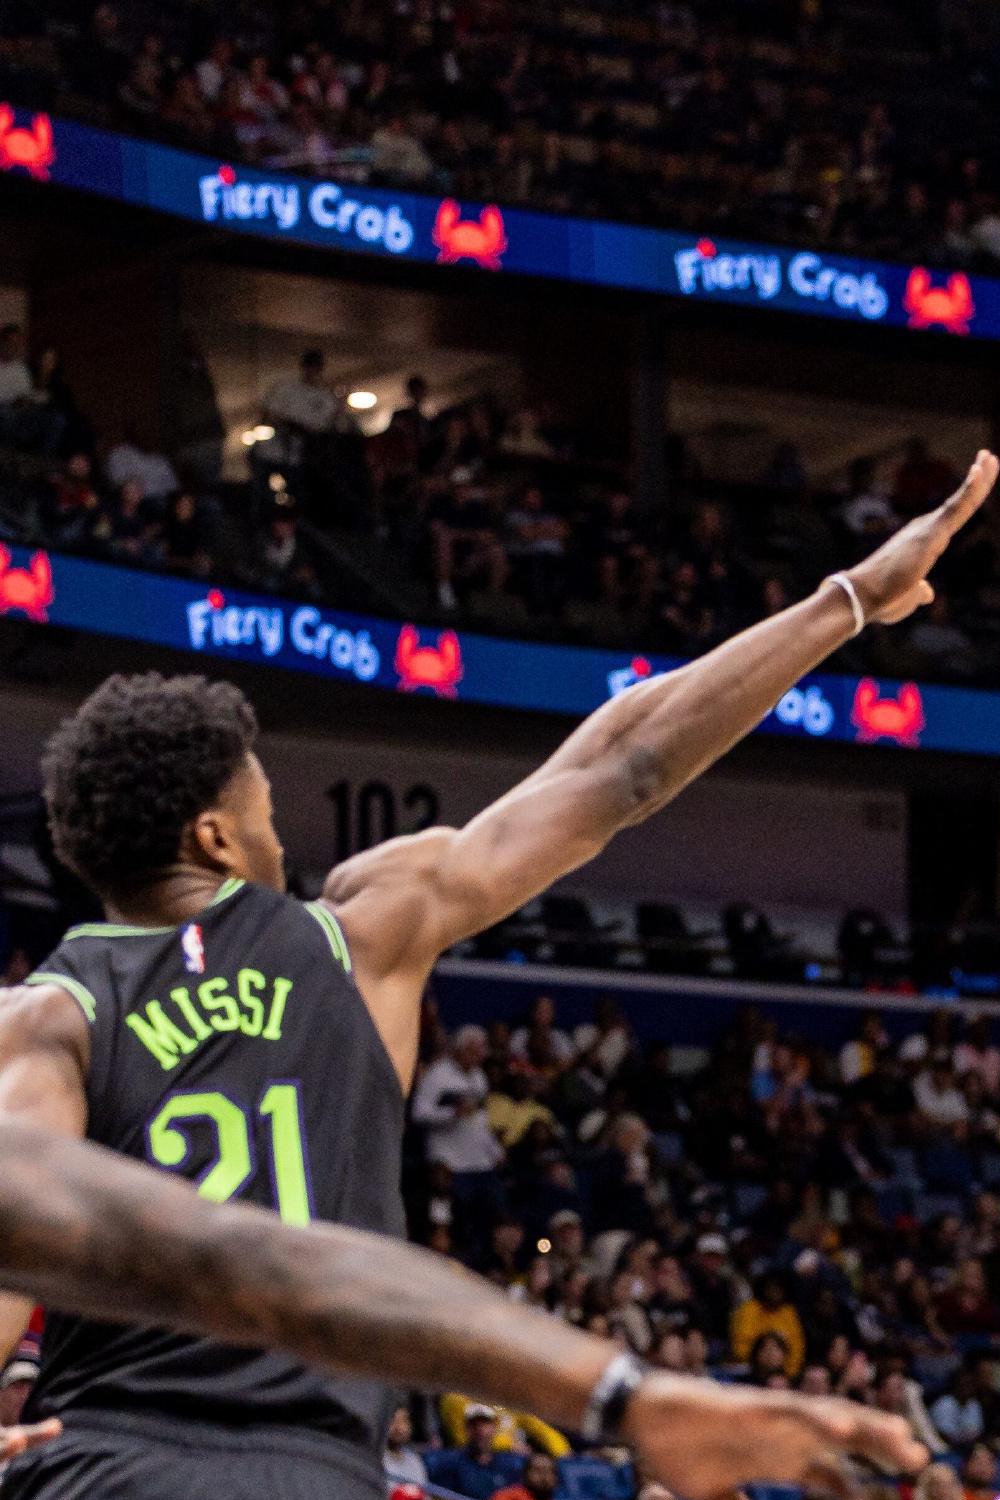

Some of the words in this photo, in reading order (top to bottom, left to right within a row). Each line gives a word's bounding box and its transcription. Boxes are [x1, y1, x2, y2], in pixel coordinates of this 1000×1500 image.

[199, 165, 300, 230] Fiery
[674, 237, 782, 300] Fiery
[187, 588, 283, 656] Fiery
[773, 685, 835, 736] ab
[125, 968, 293, 1071] MISSI
[148, 1080, 314, 1228] 21
